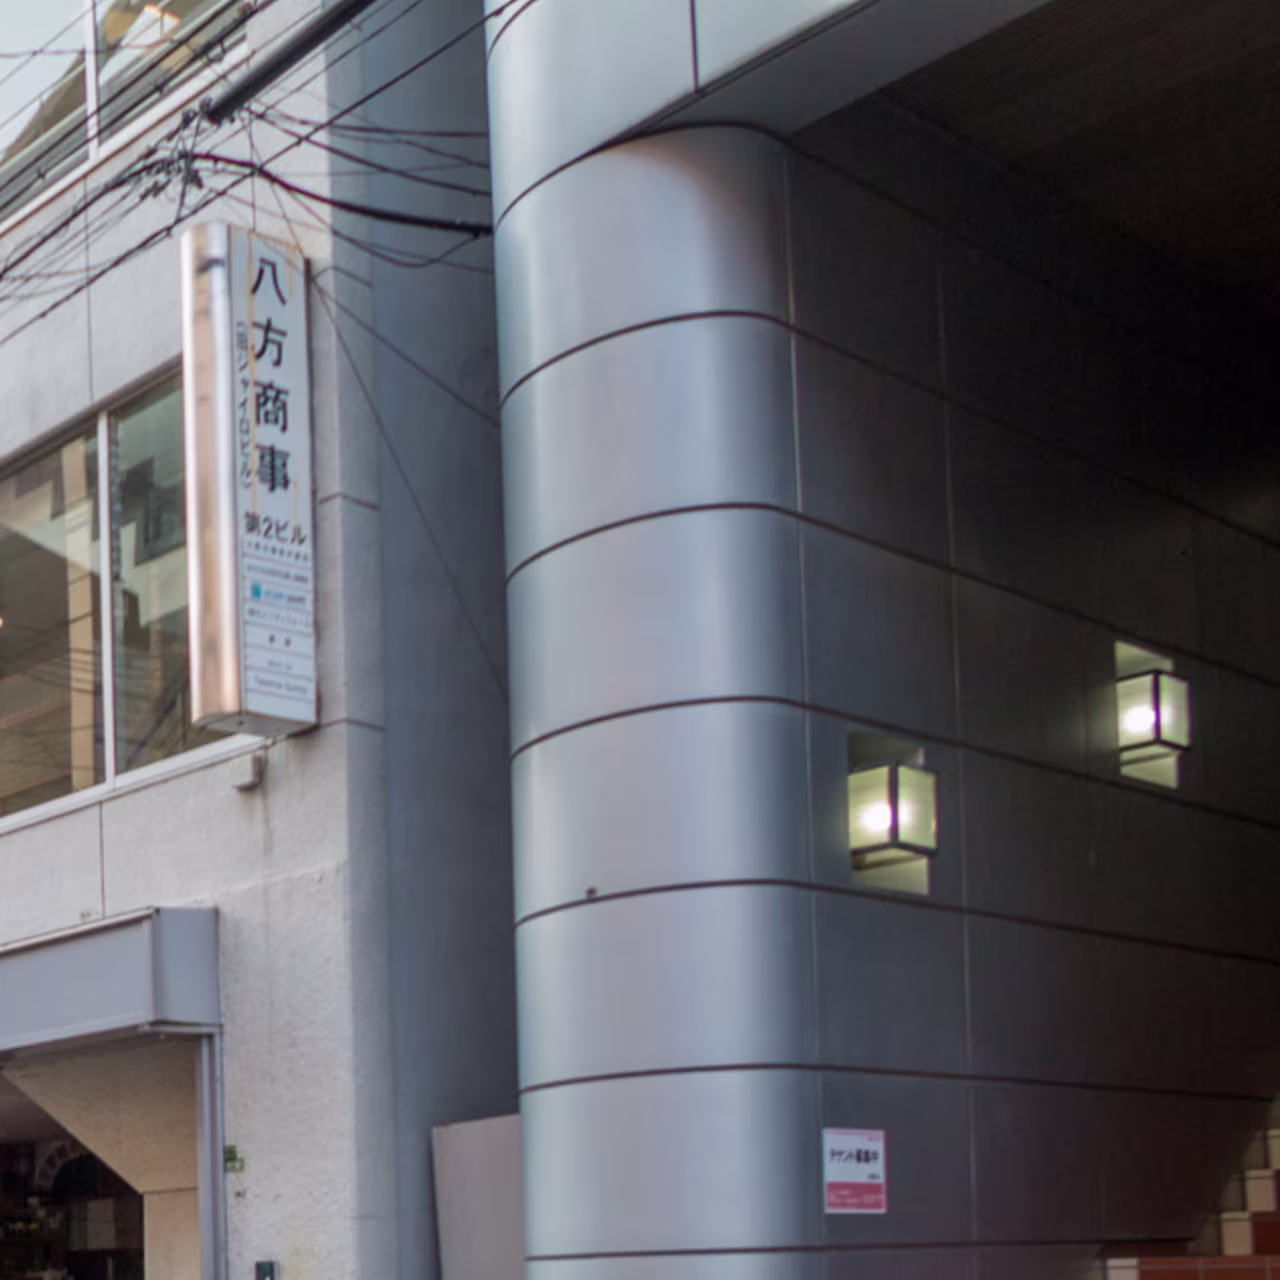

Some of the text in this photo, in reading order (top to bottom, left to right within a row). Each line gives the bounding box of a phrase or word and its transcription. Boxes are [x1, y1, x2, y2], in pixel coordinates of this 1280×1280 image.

[251, 257, 291, 493] 八方商事
[244, 511, 307, 546] 第2ビル
